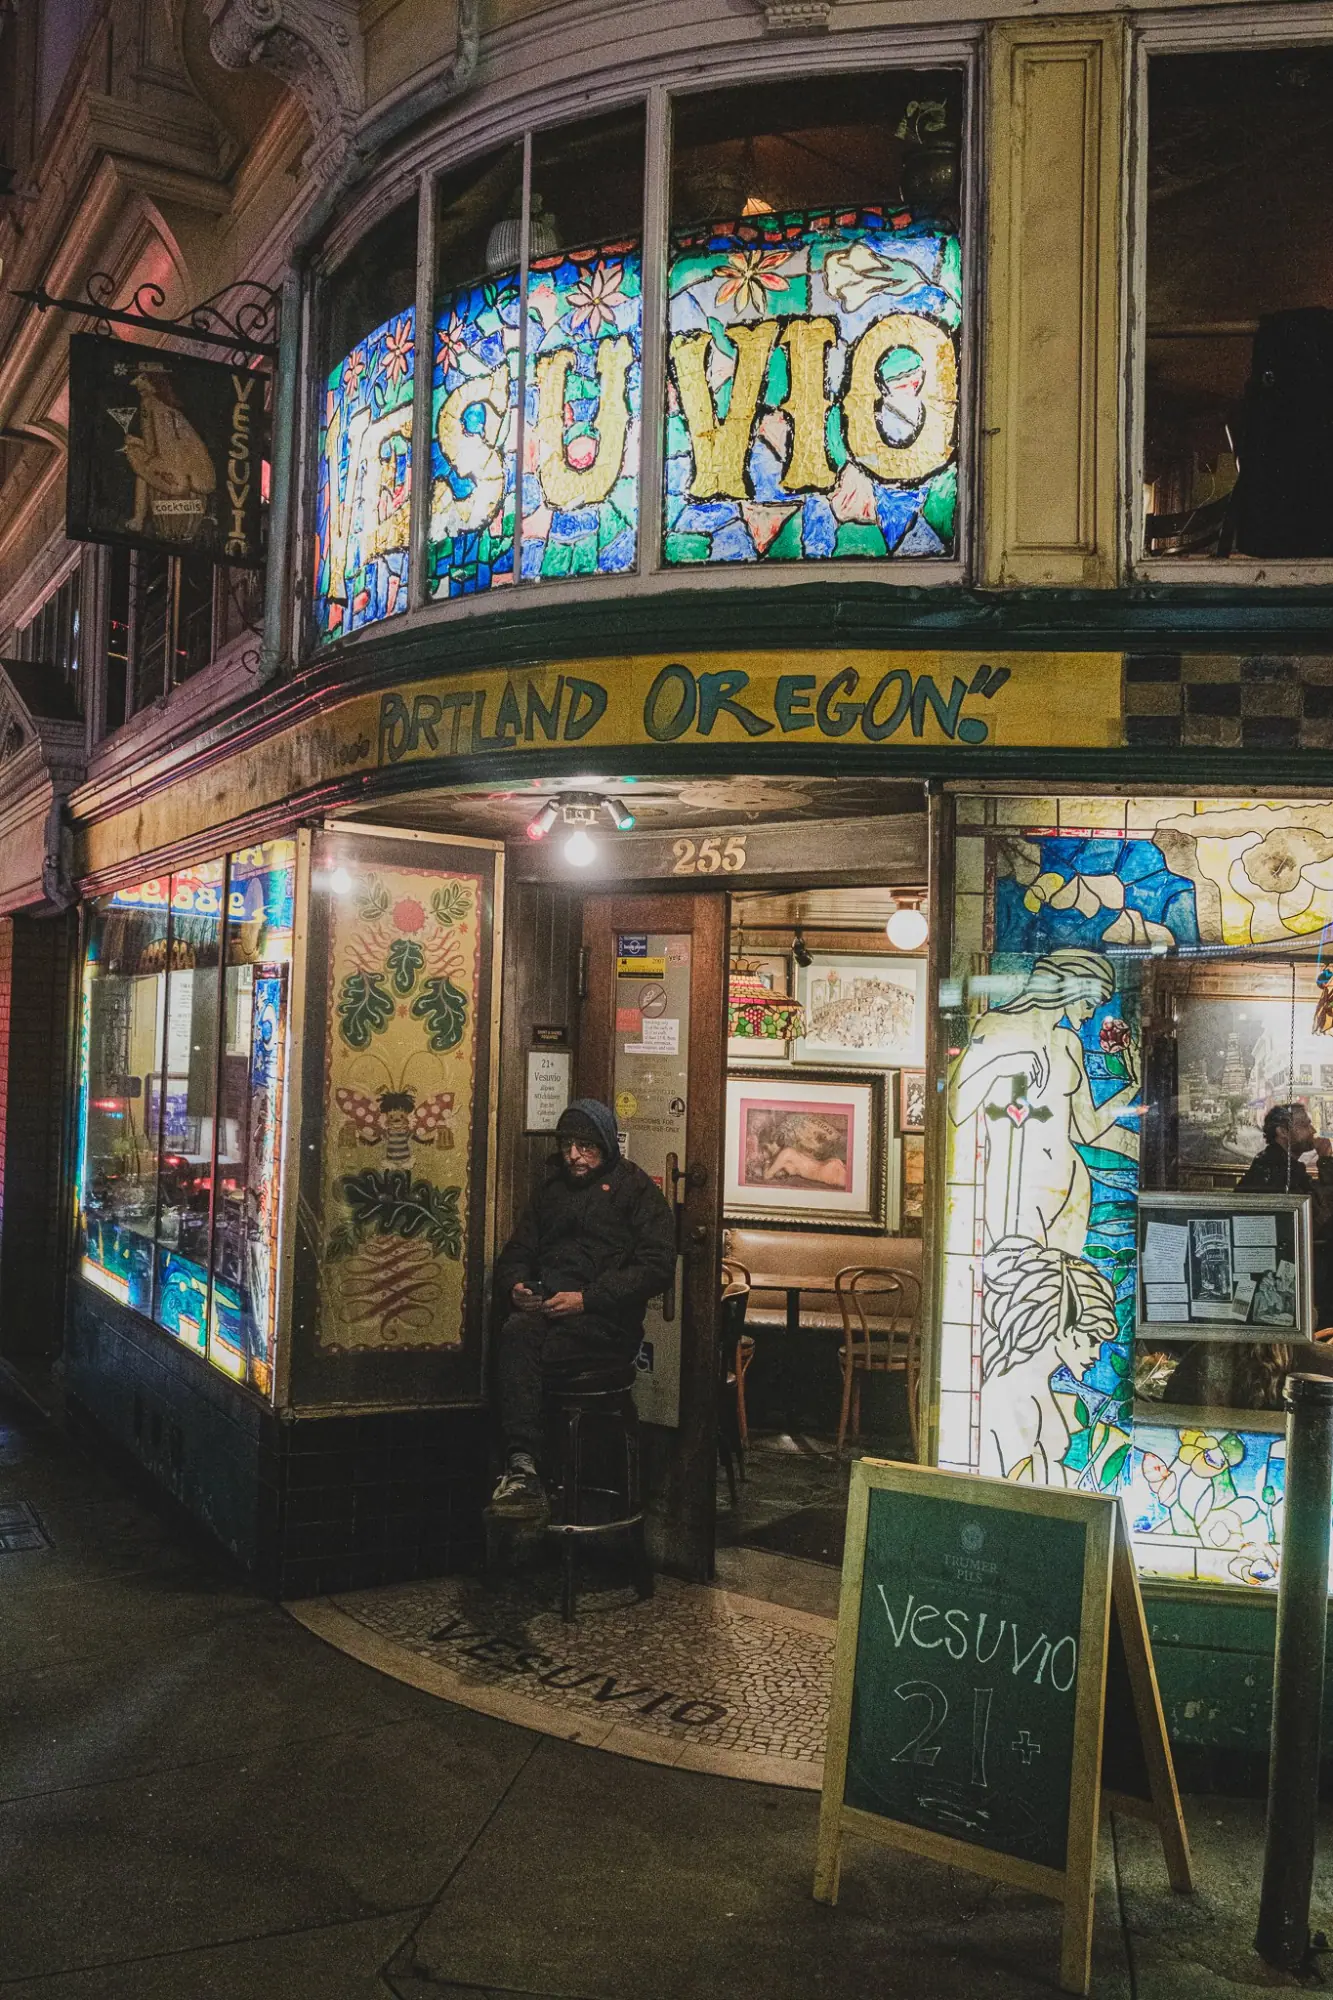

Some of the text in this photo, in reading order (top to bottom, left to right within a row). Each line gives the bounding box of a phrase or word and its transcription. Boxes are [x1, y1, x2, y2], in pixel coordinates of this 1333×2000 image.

[322, 311, 960, 602] VESUVIO
[155, 501, 201, 513] cocktails
[377, 674, 609, 768] PORTLAND
[672, 836, 747, 875] 255
[541, 1059, 554, 1068] 21+
[534, 1072, 561, 1082] Vesuvio
[943, 1553, 998, 1574] TRUMER
[956, 1568, 984, 1584] PILS
